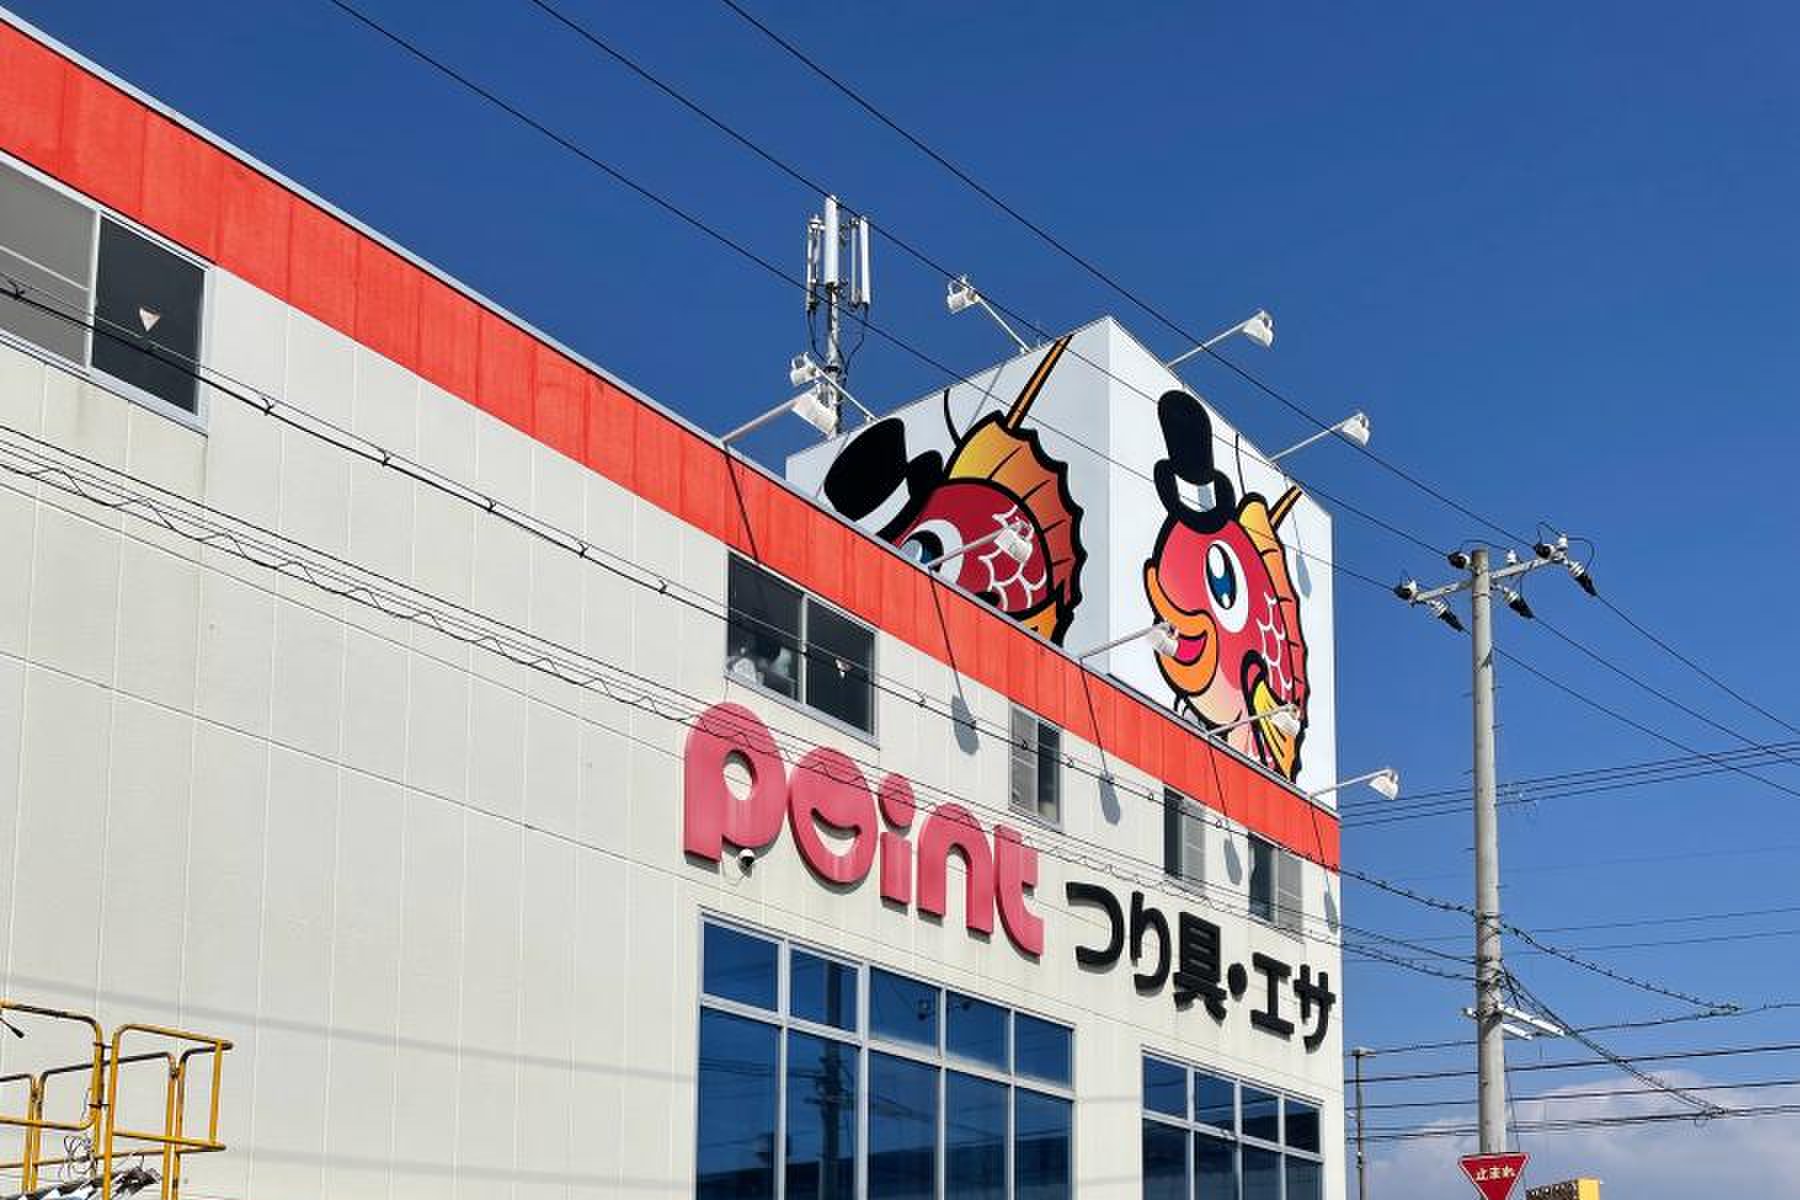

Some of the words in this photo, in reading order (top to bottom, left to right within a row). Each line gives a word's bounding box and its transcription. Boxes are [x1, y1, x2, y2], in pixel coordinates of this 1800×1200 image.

[1067, 881, 1335, 1050] つり具・エサ
[1475, 1164, 1515, 1181] 止まれ
